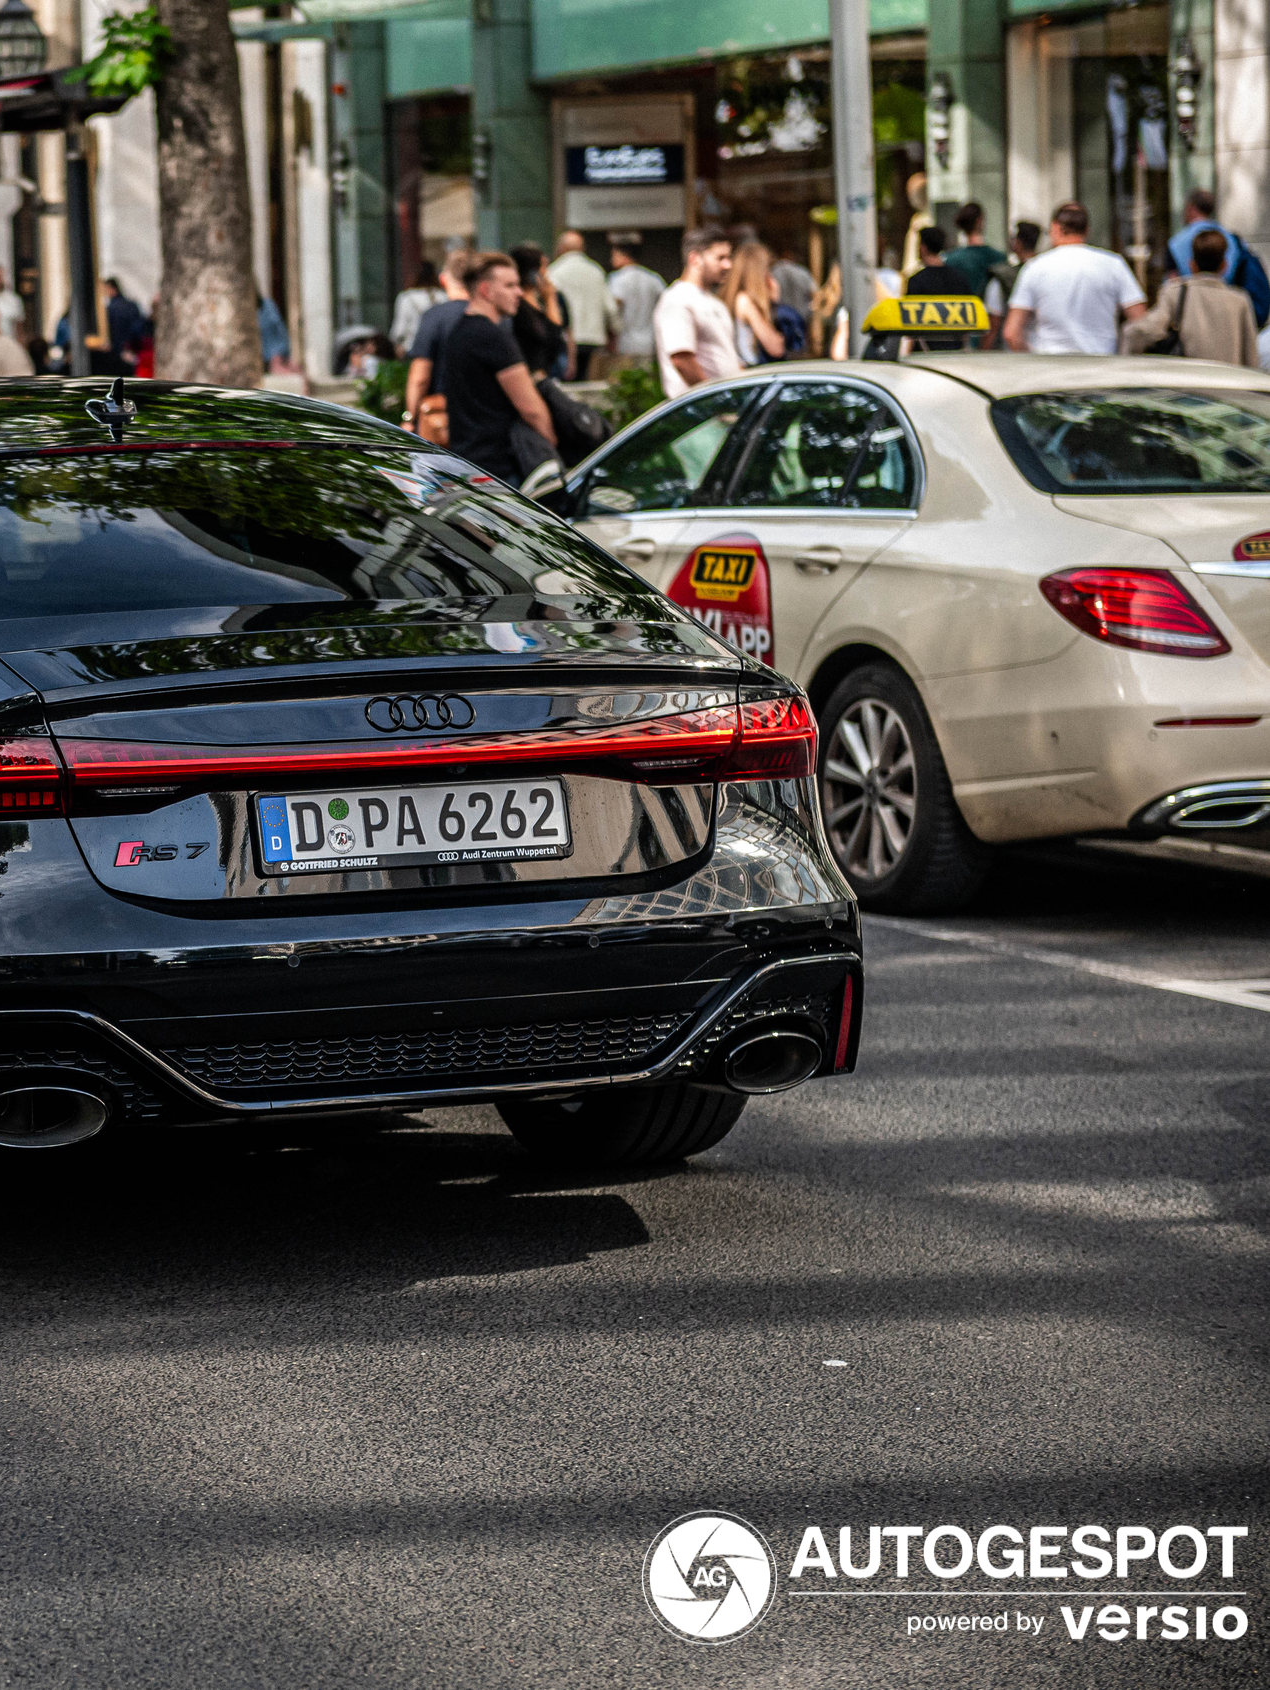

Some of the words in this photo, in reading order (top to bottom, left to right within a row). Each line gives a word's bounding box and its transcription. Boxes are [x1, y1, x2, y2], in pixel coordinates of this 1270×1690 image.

[901, 302, 976, 325] TAXI
[1249, 542, 1270, 555] TA
[702, 555, 748, 582] TAXI
[726, 622, 771, 661] APP
[291, 801, 325, 852] D
[358, 795, 426, 848] PA
[439, 788, 558, 842] 6262
[127, 843, 179, 863] RS
[186, 842, 210, 860] 7
[271, 836, 282, 850] D
[462, 851, 480, 860] Audi
[482, 849, 515, 858] Zentrum
[515, 846, 557, 857] Wuppertal
[290, 859, 338, 871] GOTTFRIED
[340, 857, 378, 868] SCHULTZ
